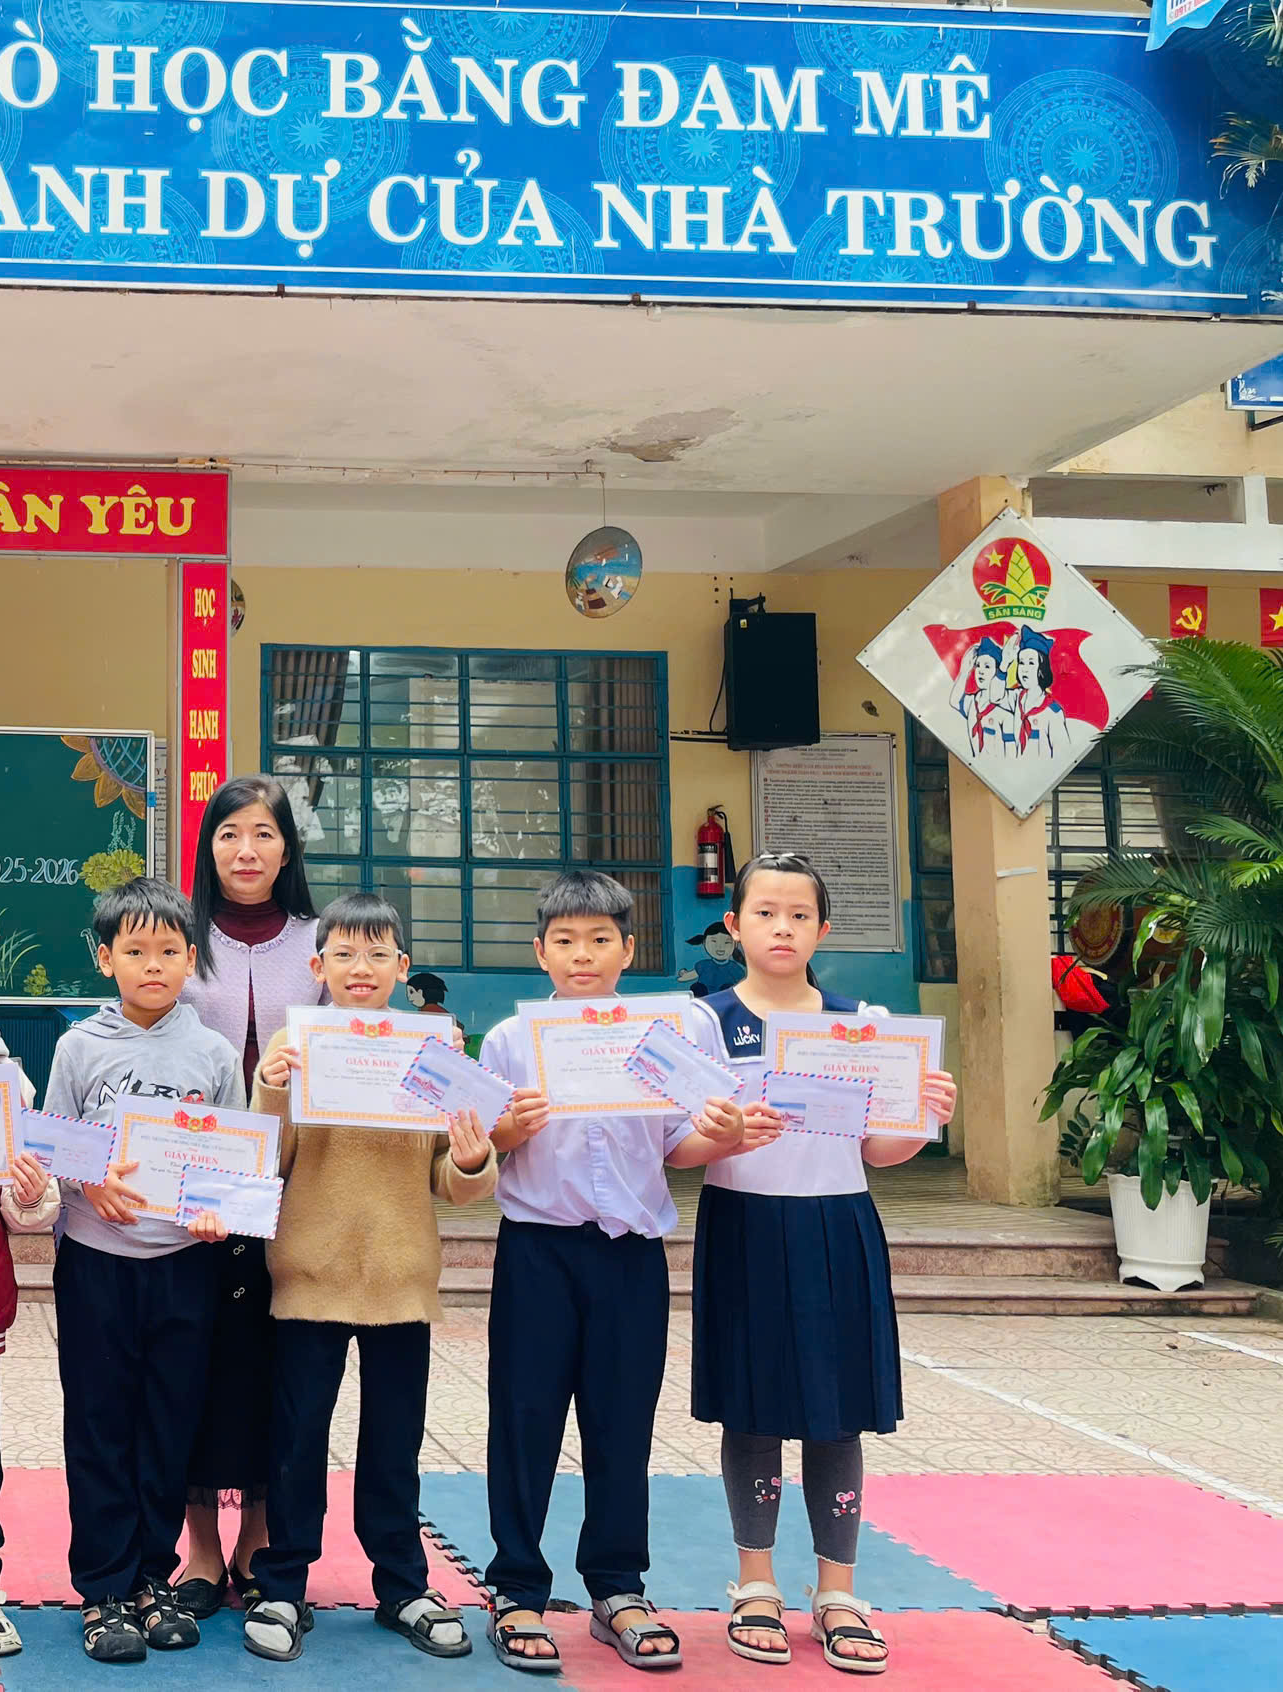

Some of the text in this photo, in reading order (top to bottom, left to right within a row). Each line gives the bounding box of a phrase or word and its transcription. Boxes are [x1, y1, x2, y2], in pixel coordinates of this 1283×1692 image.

[89, 45, 288, 132] HỌC
[321, 18, 586, 127] BẰNG
[615, 63, 826, 134] ĐAM
[852, 55, 990, 140] MÊ
[200, 158, 341, 258] DỰ
[369, 149, 563, 247] CỦA
[593, 166, 797, 253] NHÀ
[826, 175, 1216, 268] TRƯỜNG
[79, 484, 196, 536] YÊU
[189, 588, 219, 801] HỌC SINH HẠNH PHÚC
[733, 1033, 761, 1047] LUCKY
